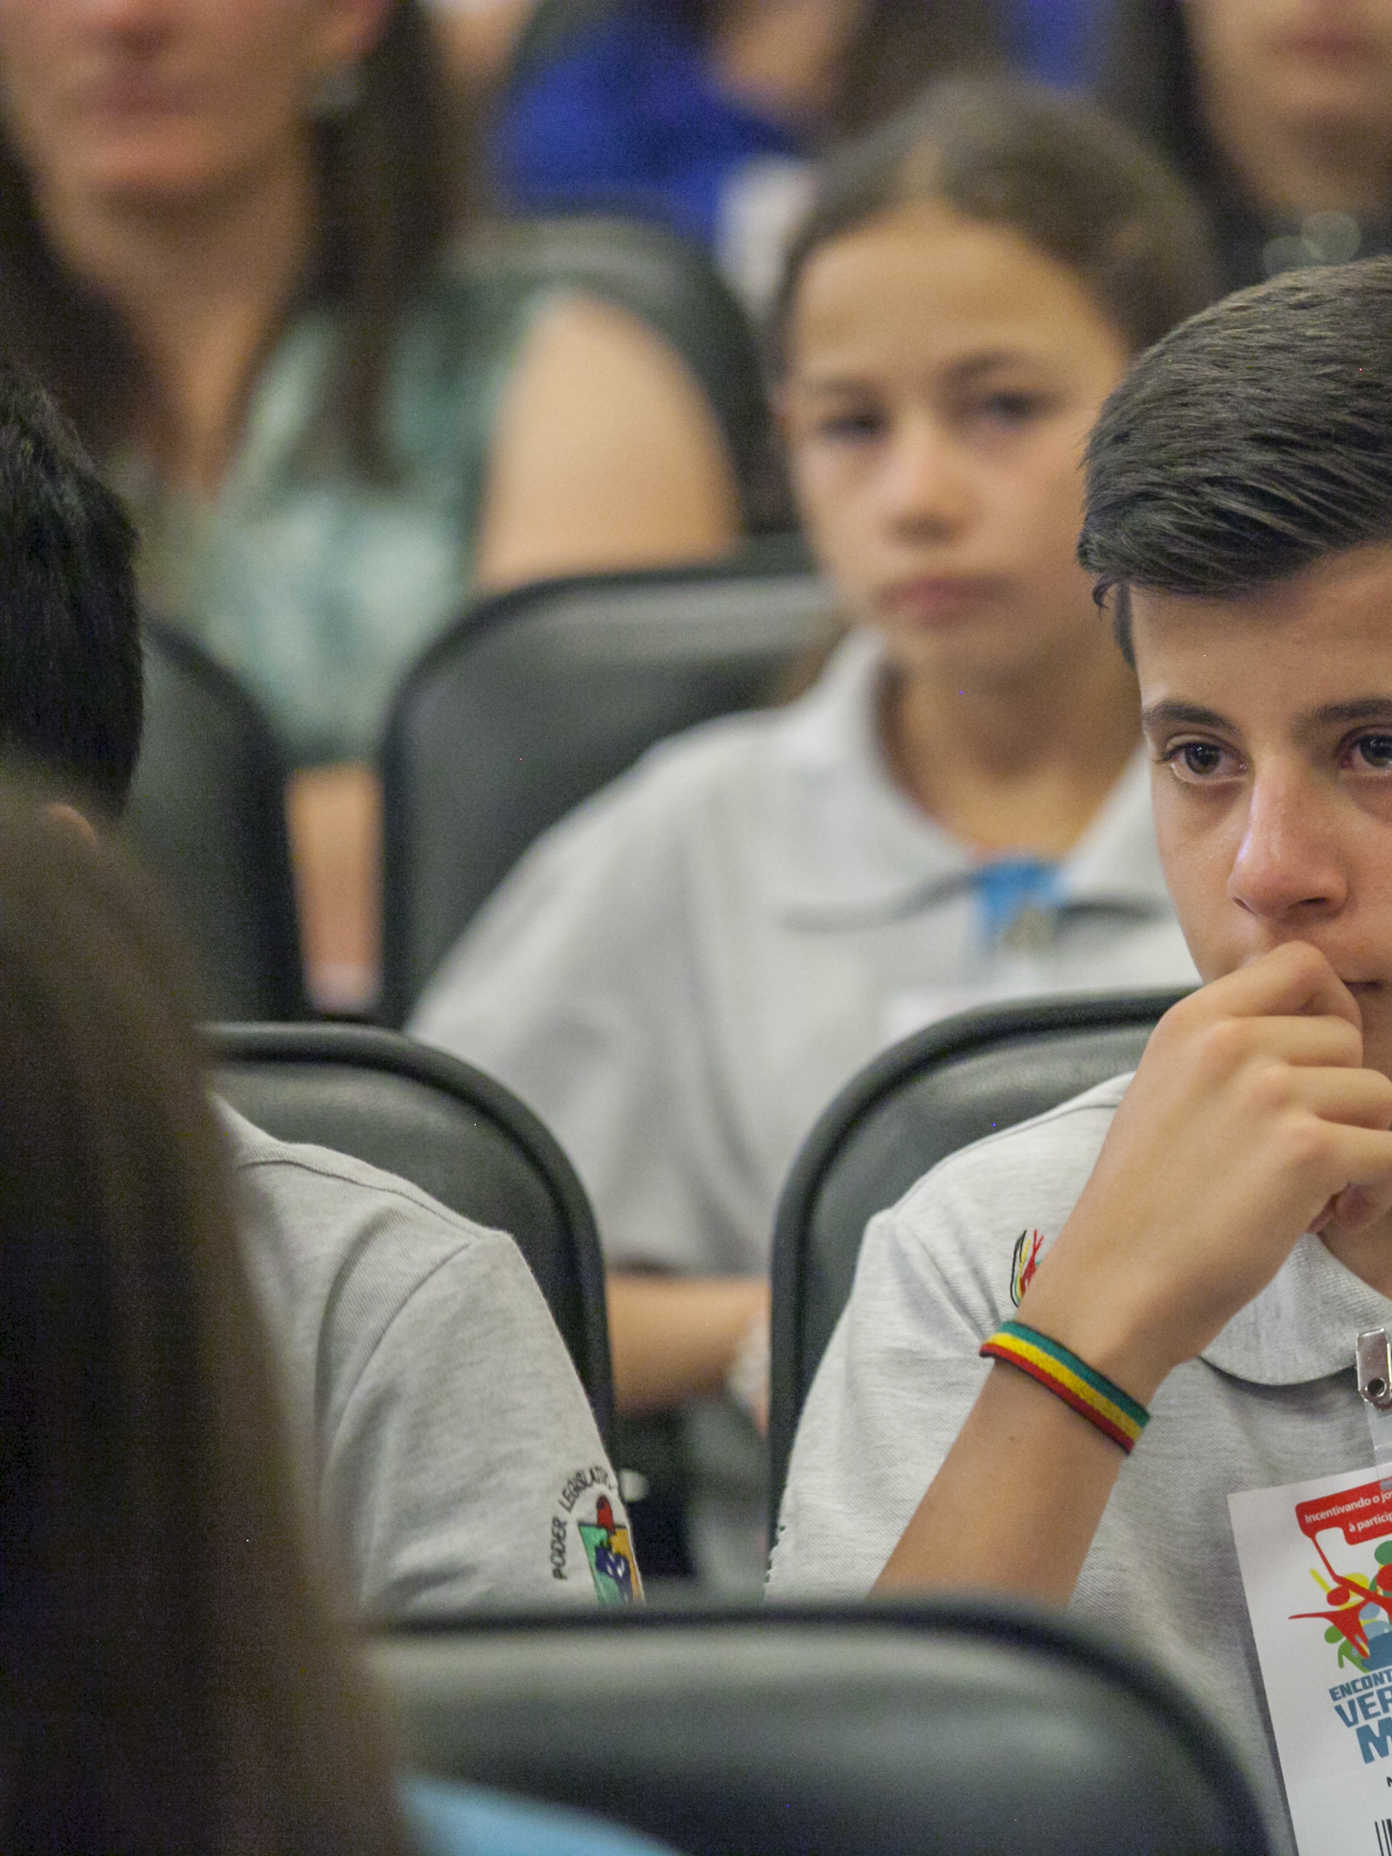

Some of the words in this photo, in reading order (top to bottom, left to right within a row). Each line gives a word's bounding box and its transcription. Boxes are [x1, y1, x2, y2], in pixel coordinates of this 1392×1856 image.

[1304, 1497, 1372, 1524] Incentivando
[1373, 1493, 1380, 1504] o
[551, 1516, 568, 1581] PODER
